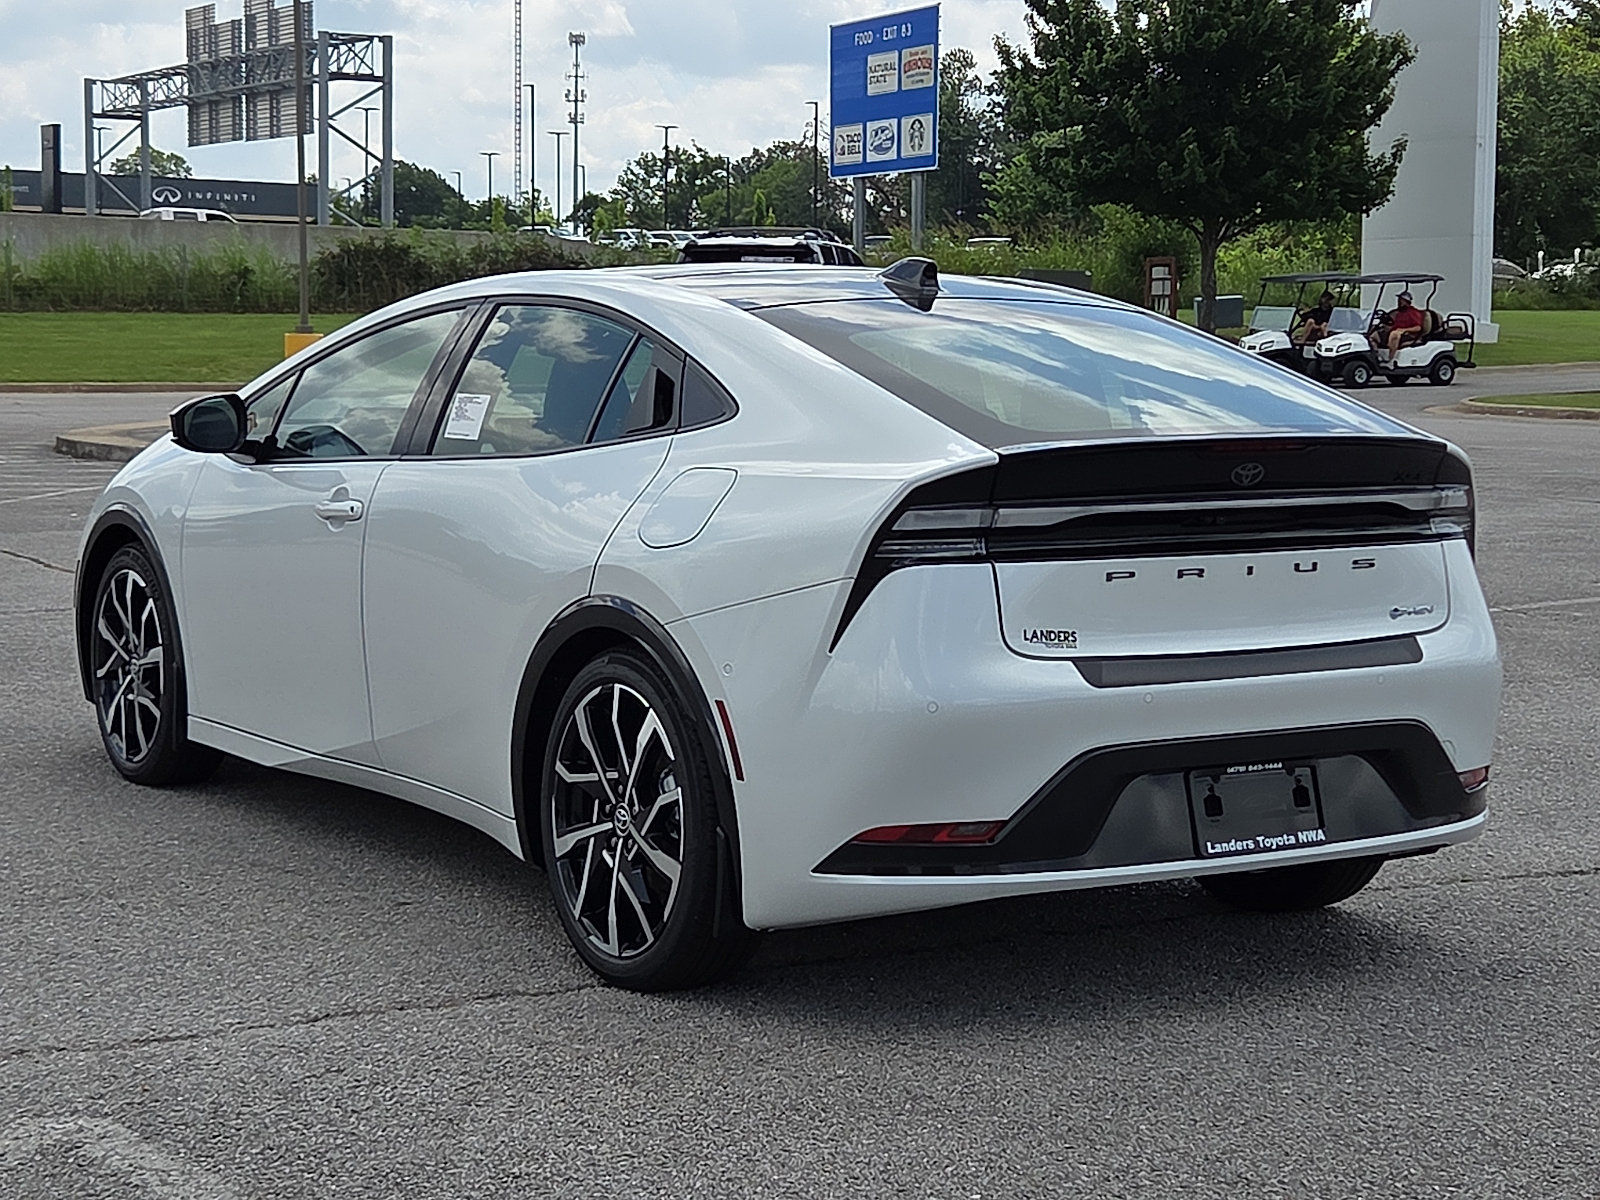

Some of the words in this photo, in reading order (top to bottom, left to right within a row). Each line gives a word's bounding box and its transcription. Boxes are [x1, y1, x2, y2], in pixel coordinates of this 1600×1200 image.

[855, 30, 873, 46] FOOD
[882, 26, 897, 40] EXIT
[869, 61, 896, 73] NATURAL
[869, 73, 887, 85] STATE
[846, 132, 861, 144] TACO
[847, 144, 861, 155] BELL
[188, 192, 255, 202] INFINITI
[1105, 558, 1376, 583] PRIUS
[1023, 628, 1077, 643] LANDERS
[1206, 837, 1255, 854] Landers
[1256, 833, 1296, 849] Toyota
[1297, 828, 1326, 844] NWA
